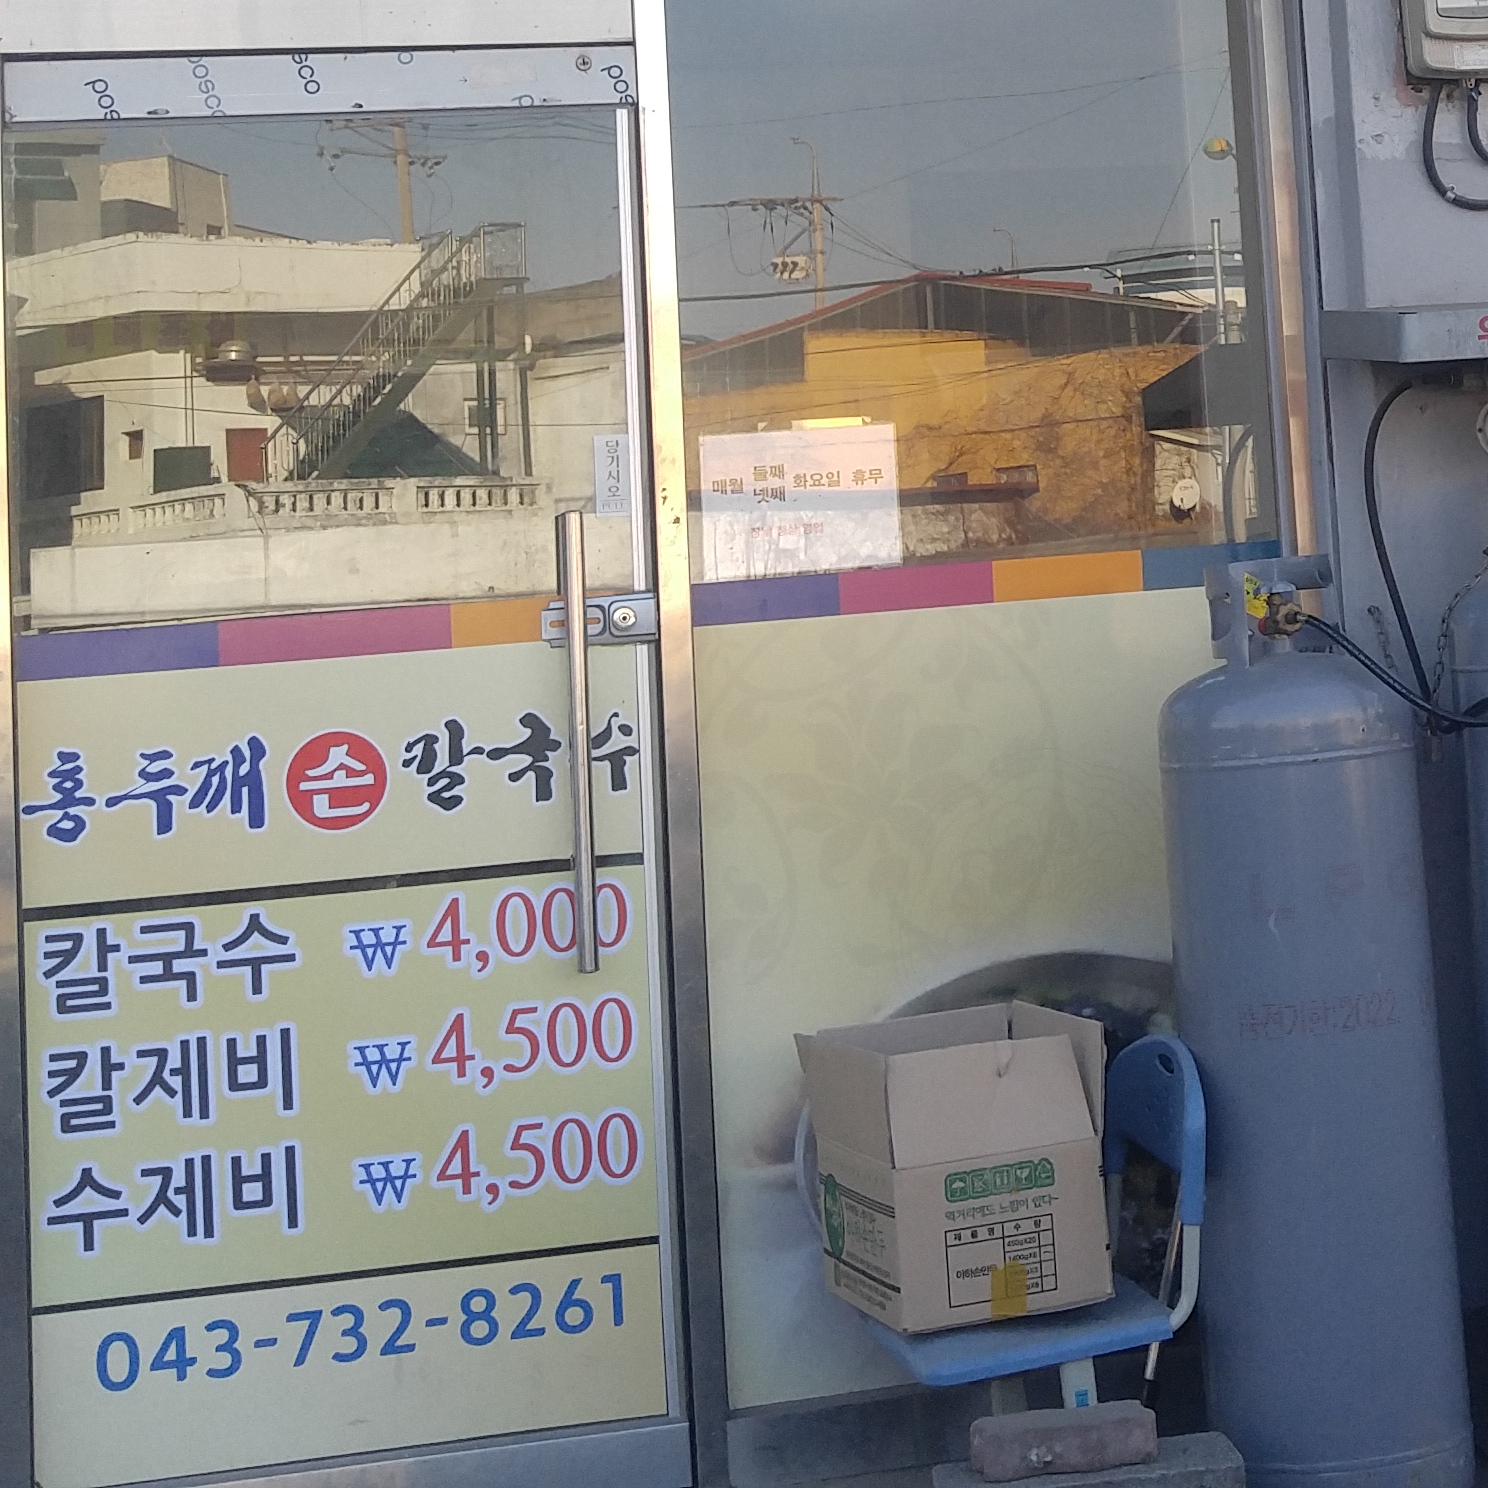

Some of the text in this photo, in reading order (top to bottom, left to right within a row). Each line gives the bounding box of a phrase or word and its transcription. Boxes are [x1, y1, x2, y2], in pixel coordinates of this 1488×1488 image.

[604, 439, 621, 498] 당기시오
[711, 467, 884, 495] 매월 화요일 휴무
[753, 485, 786, 504] 넷째
[21, 711, 641, 843] 홍두깨 손 칼국수
[41, 912, 298, 1015] 칼국수
[45, 1026, 293, 1135] 칼제비
[46, 1144, 301, 1253] 수제비
[95, 1272, 626, 1393] 043-732-8261
